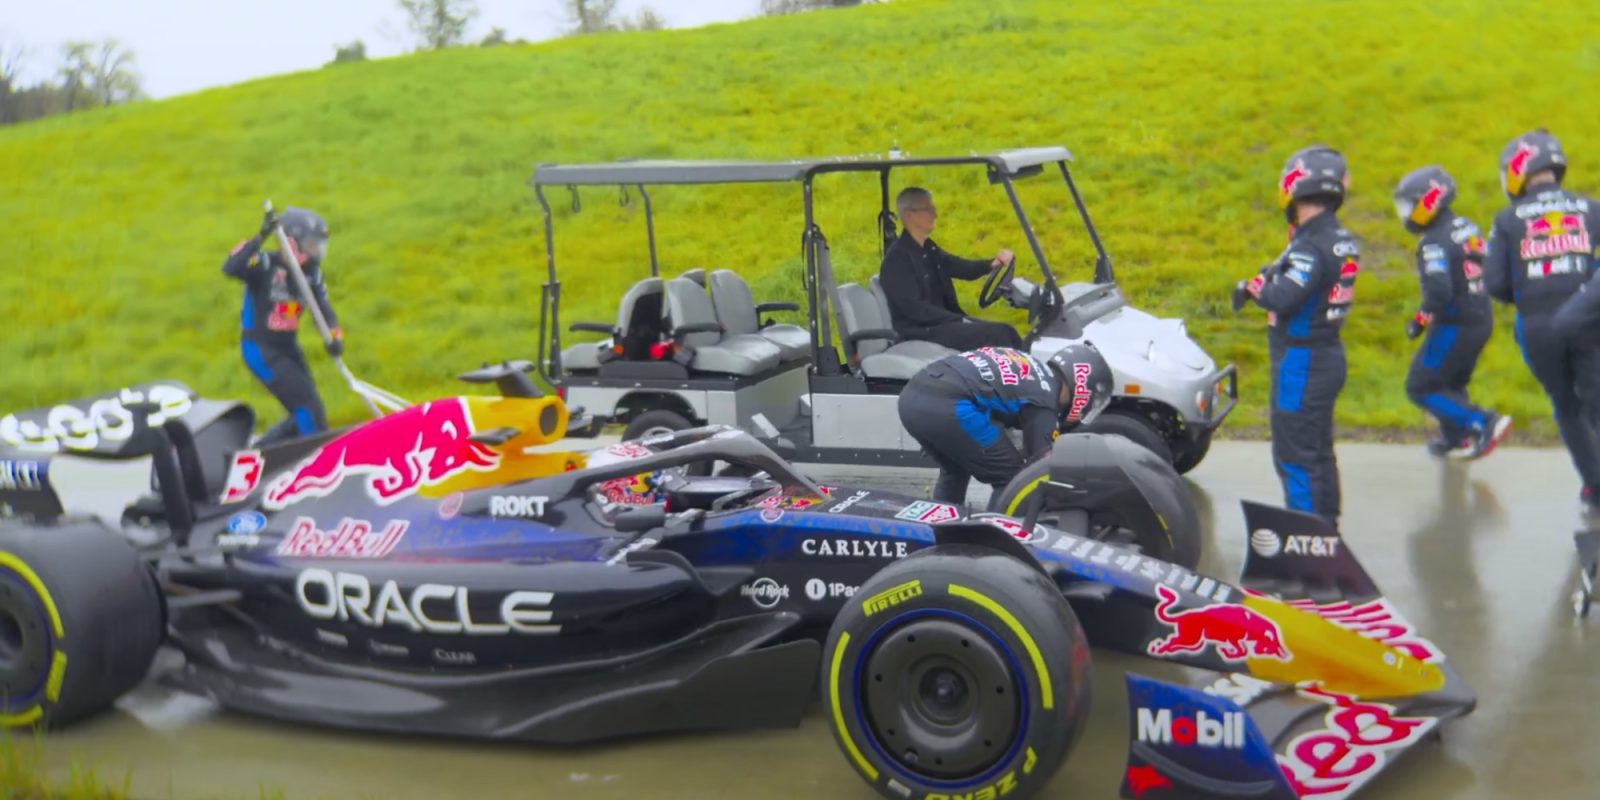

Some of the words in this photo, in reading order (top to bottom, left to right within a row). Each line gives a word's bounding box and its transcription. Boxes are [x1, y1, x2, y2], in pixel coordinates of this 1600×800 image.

[490, 496, 549, 517] ROKT
[802, 539, 908, 558] CARLYLE
[1283, 534, 1339, 557] AT&T
[296, 567, 563, 634] ORACLE
[862, 579, 923, 617] PIRELLI
